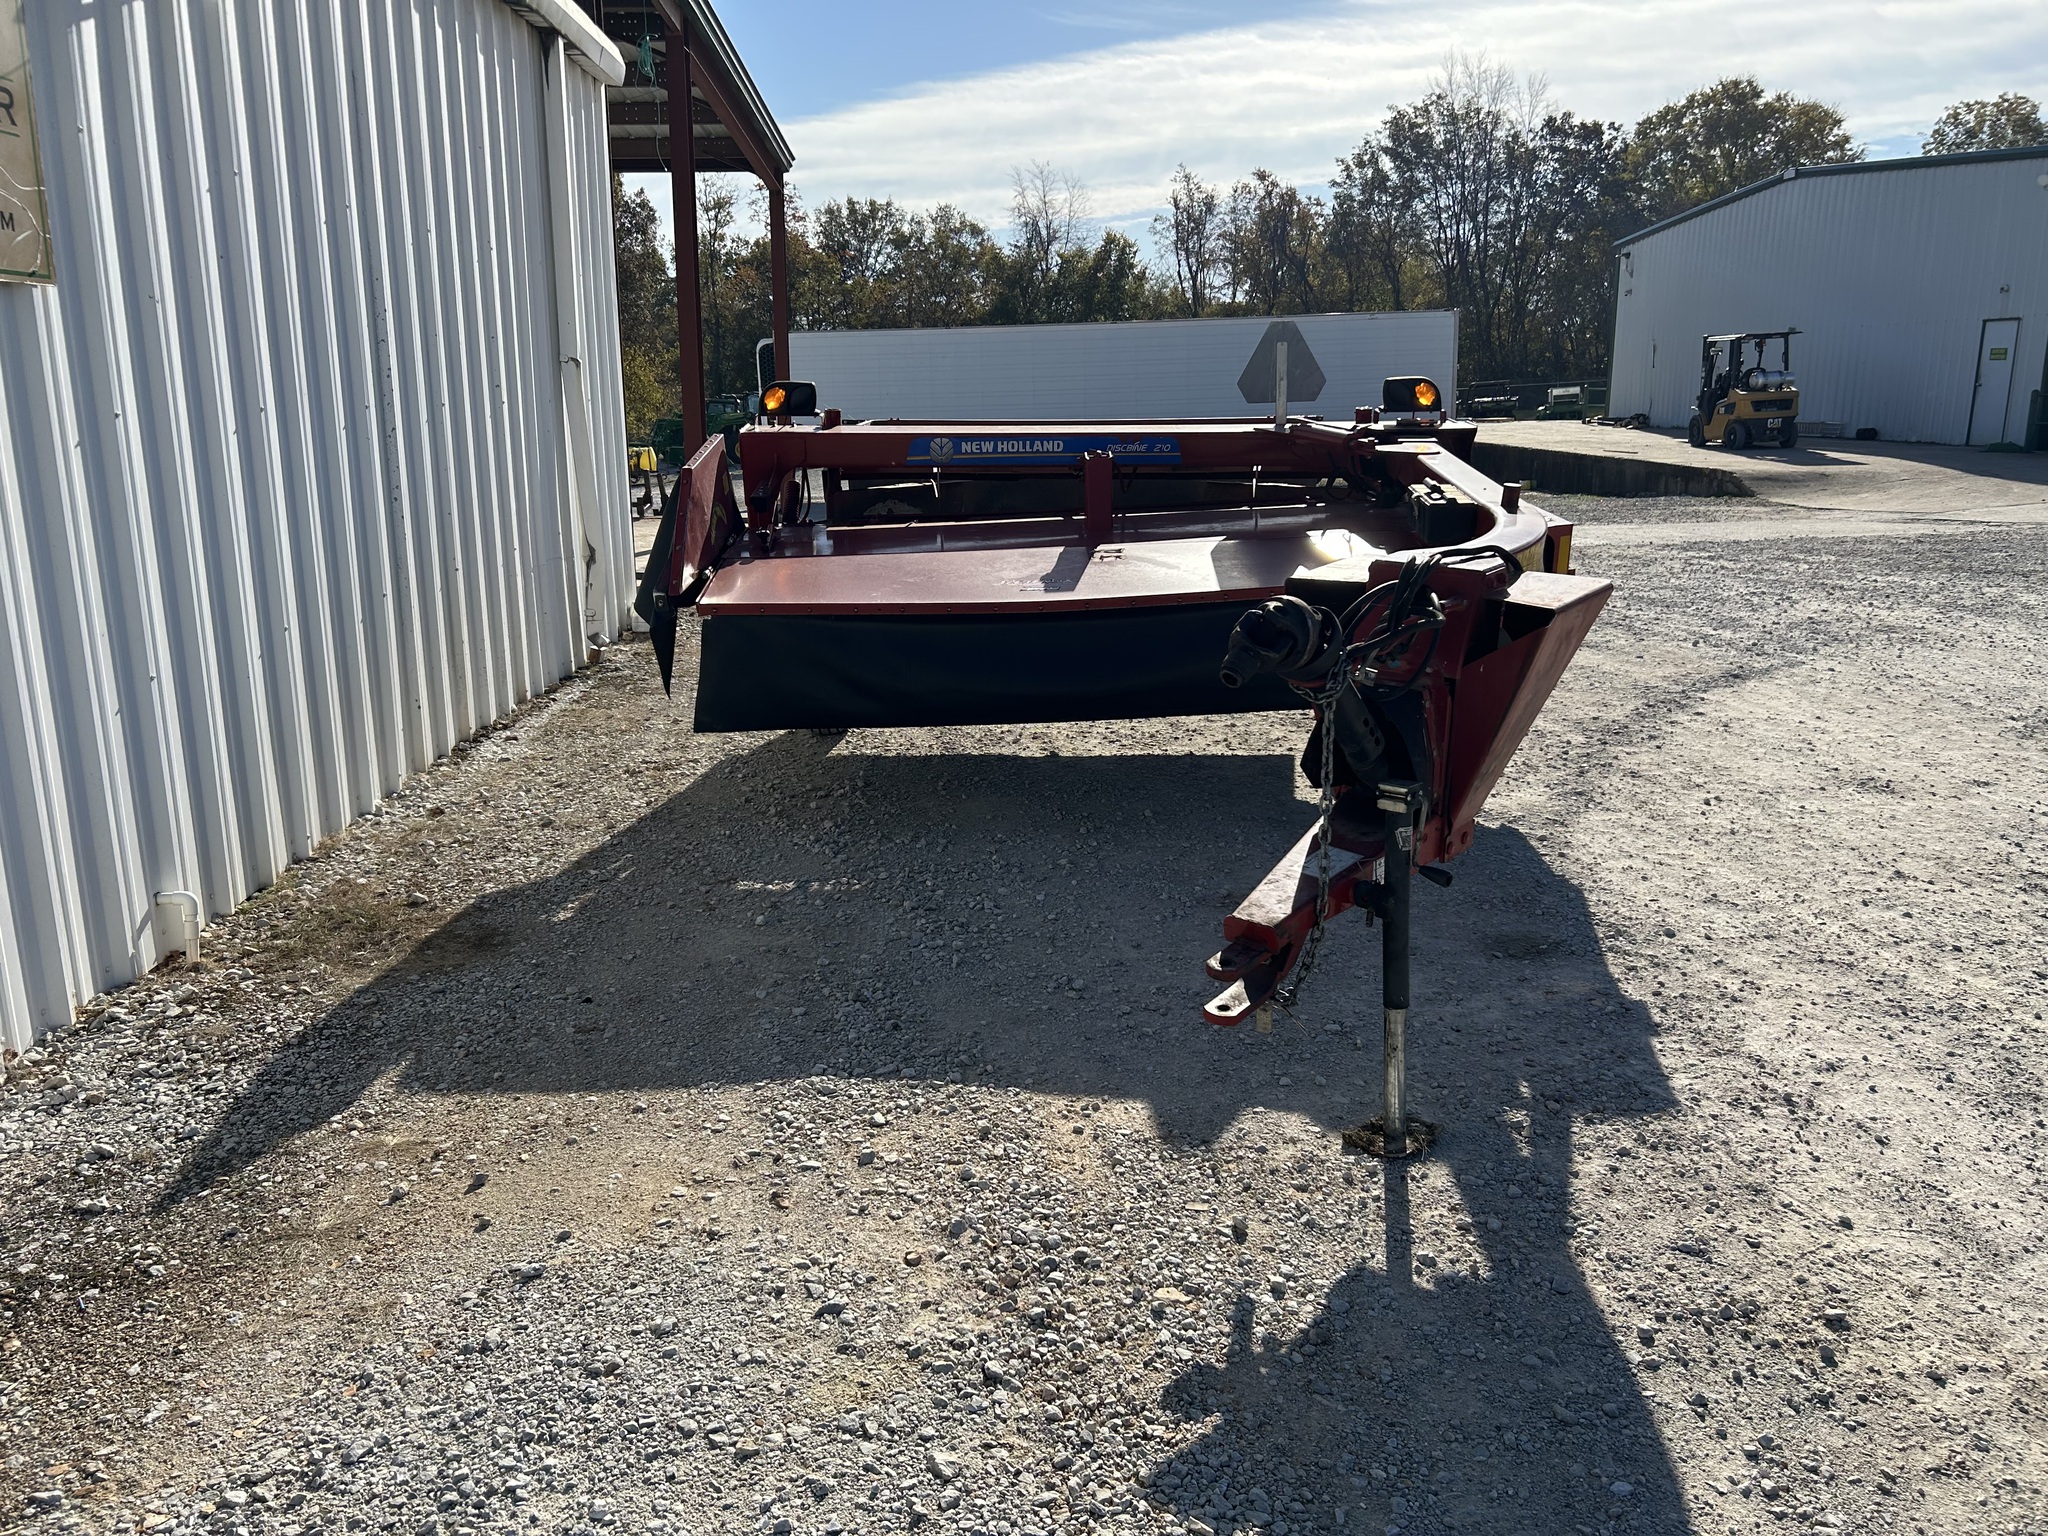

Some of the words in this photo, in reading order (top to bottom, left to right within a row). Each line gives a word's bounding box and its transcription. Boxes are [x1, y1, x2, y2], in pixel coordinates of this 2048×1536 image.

[1767, 418, 1782, 428] CAT
[961, 440, 994, 453] NEW
[997, 440, 1064, 453] HOLLAND
[1153, 444, 1171, 452] 210
